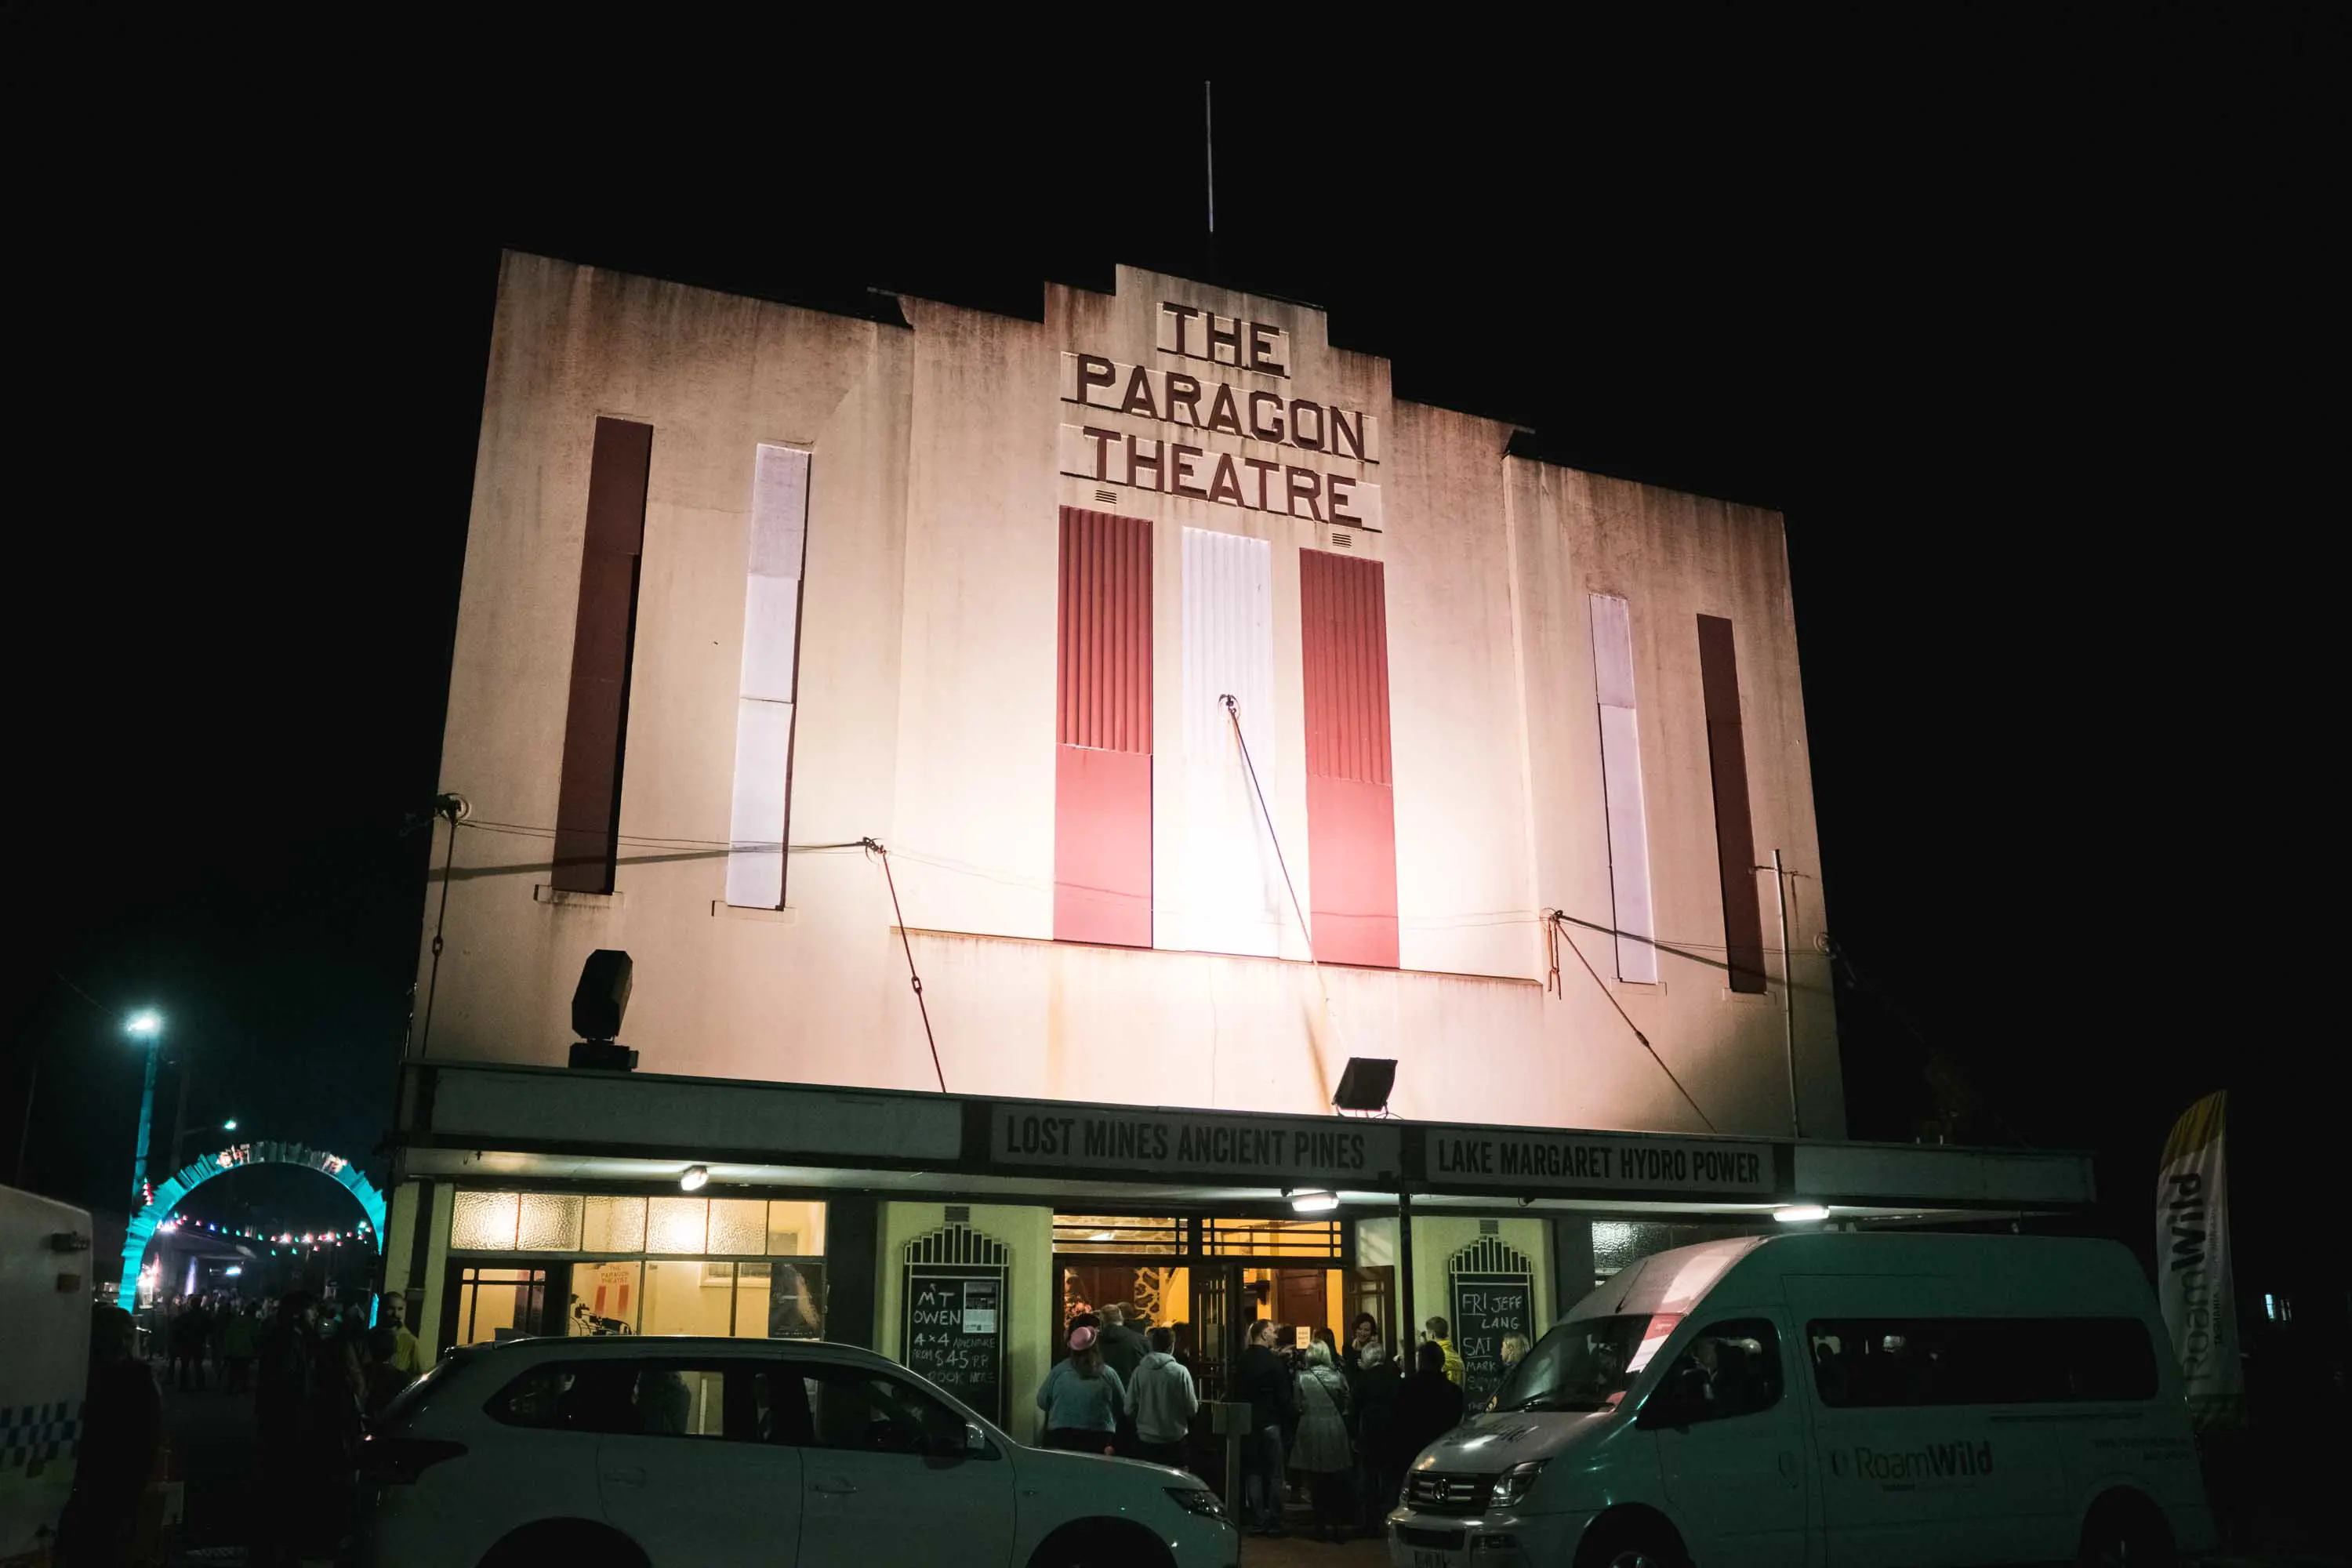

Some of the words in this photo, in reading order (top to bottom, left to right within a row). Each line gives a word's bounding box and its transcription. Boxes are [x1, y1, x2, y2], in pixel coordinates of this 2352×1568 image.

[1163, 301, 1285, 377] THE
[1076, 353, 1365, 461] PARAGON
[1083, 426, 1363, 529] THEATRE
[1007, 1115, 1075, 1156] LOST
[1084, 1119, 1169, 1161] MINES
[1178, 1125, 1287, 1166] ANCIENT
[1295, 1131, 1365, 1170] PINES
[1438, 1139, 1493, 1174] LAKE
[1501, 1142, 1613, 1179] MARGARET
[1620, 1148, 1686, 1182] HYDRO
[1693, 1151, 1760, 1184] POWER
[913, 1308, 961, 1326] OWEN
[1462, 1293, 1487, 1314] FRI
[1490, 1295, 1523, 1313] JEFF
[1480, 1316, 1521, 1330] LANG
[1462, 1337, 1493, 1356] SAT
